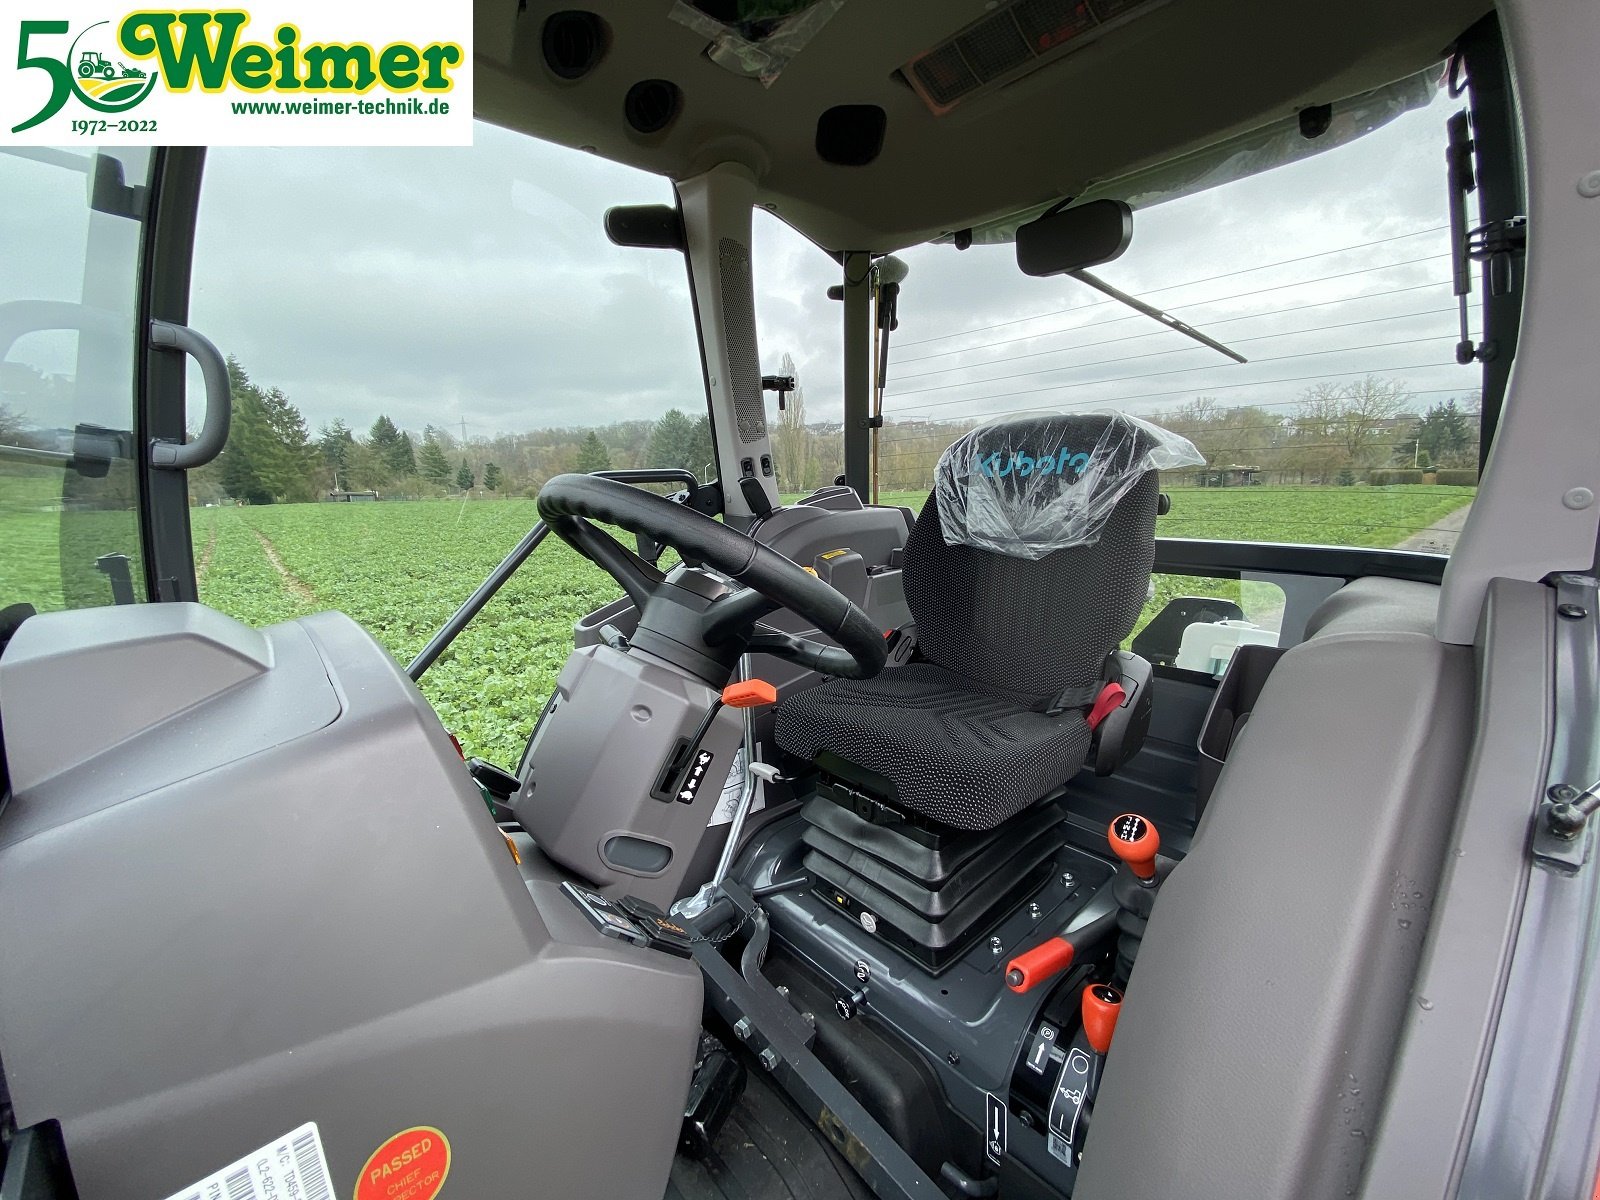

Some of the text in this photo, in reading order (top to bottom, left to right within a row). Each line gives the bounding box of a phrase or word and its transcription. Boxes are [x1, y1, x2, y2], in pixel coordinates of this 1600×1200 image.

[974, 446, 1092, 478] Kubota
[370, 1138, 432, 1185] PASSED
[386, 1167, 421, 1195] CHIEF
